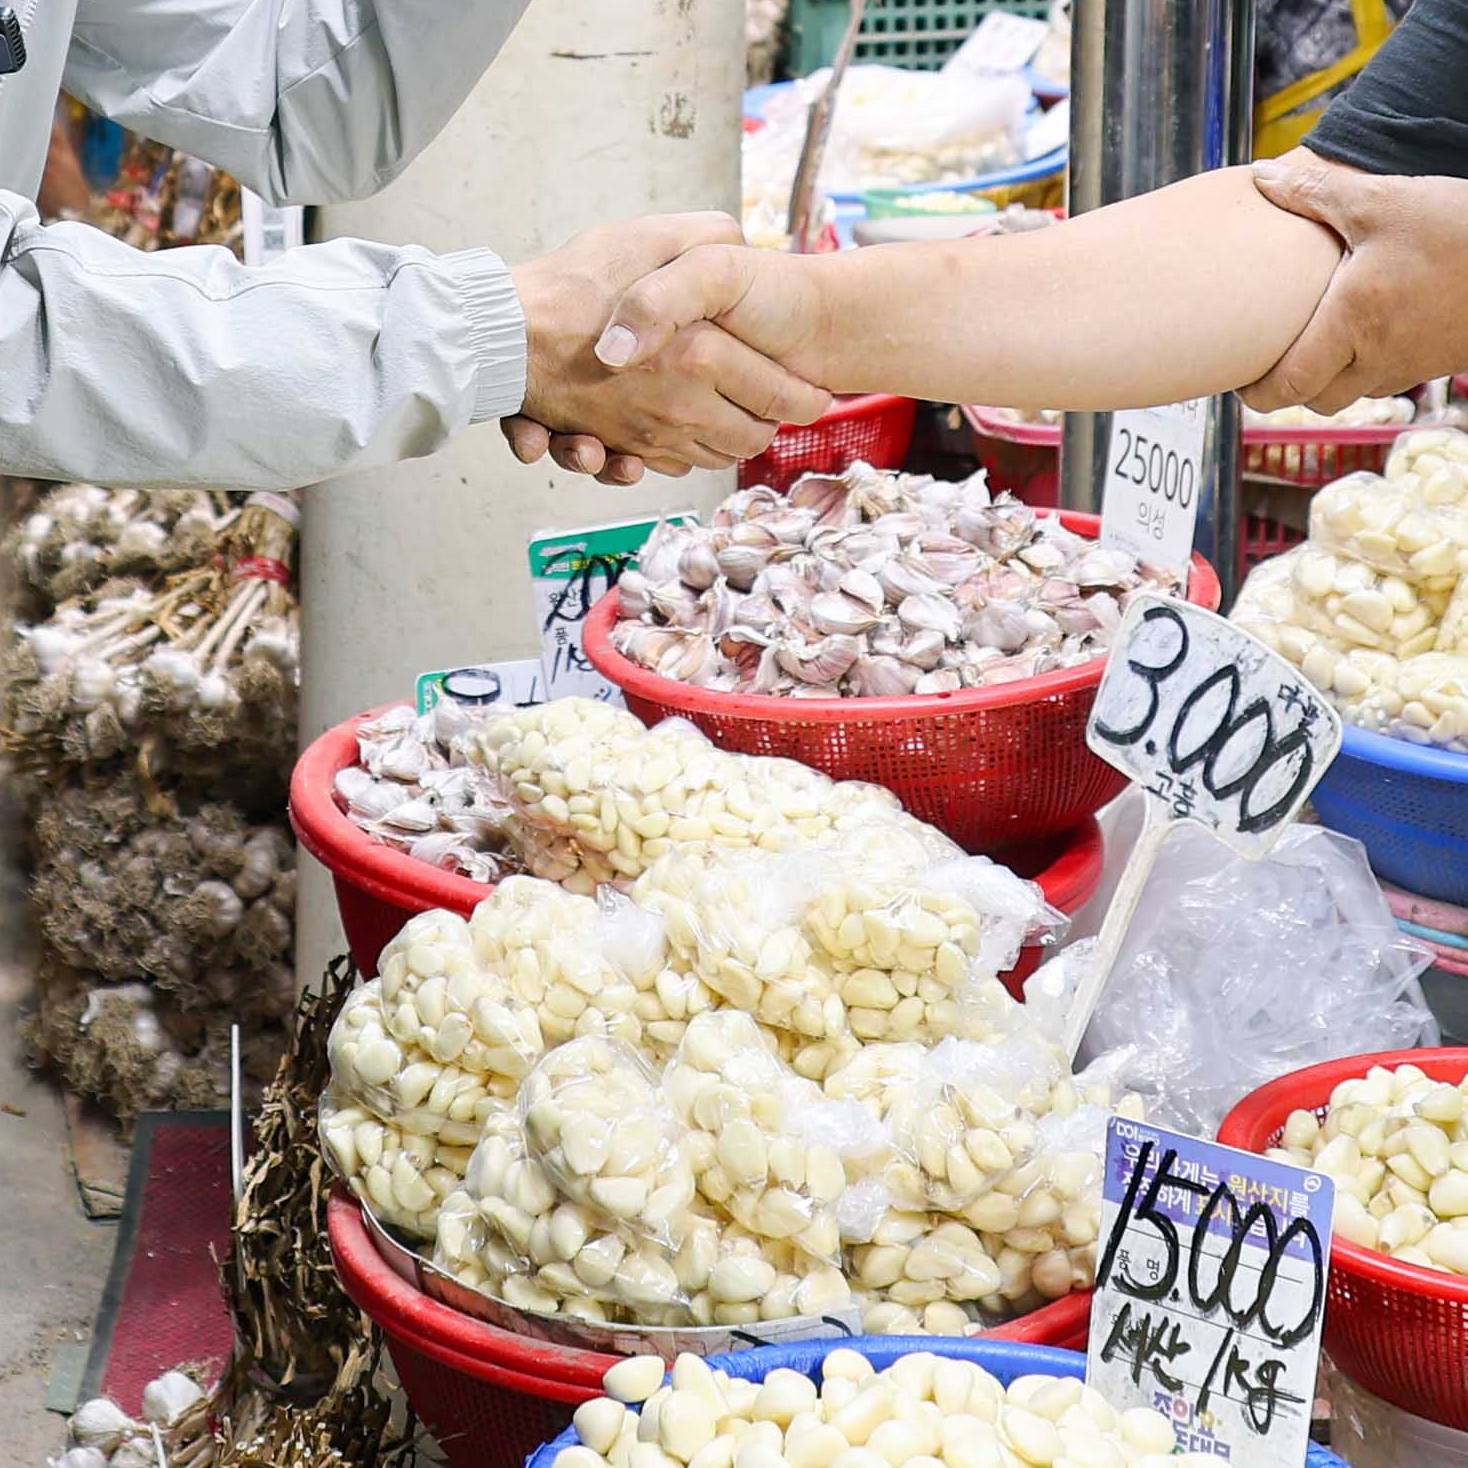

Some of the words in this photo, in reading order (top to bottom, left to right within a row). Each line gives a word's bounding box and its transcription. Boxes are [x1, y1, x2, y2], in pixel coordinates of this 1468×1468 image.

[1115, 428, 1194, 509] 25000
[1137, 502, 1166, 540] 의성
[1228, 1173, 1311, 1219] 원산지를
